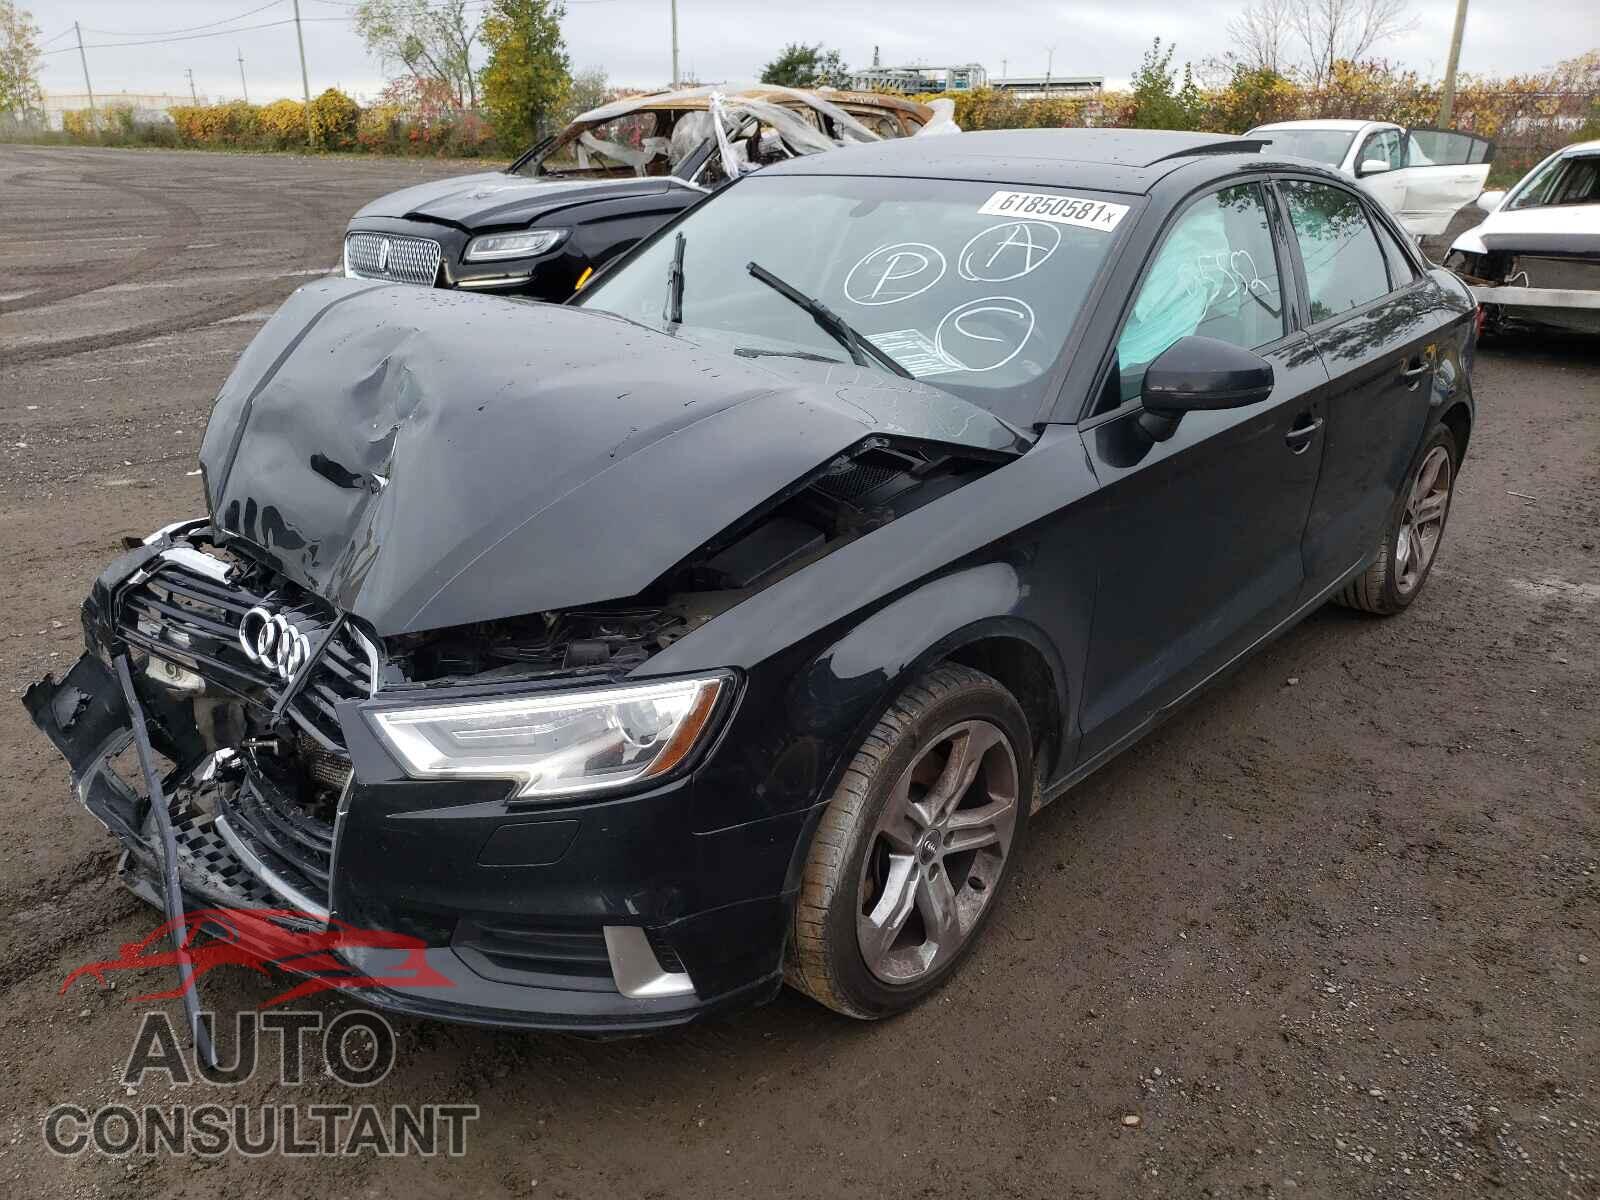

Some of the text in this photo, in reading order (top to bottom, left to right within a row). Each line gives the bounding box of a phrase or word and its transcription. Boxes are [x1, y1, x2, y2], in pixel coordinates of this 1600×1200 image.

[1000, 194, 1106, 222] 61850581
[986, 222, 1050, 272] A
[872, 252, 929, 299] P
[955, 306, 1025, 342] C
